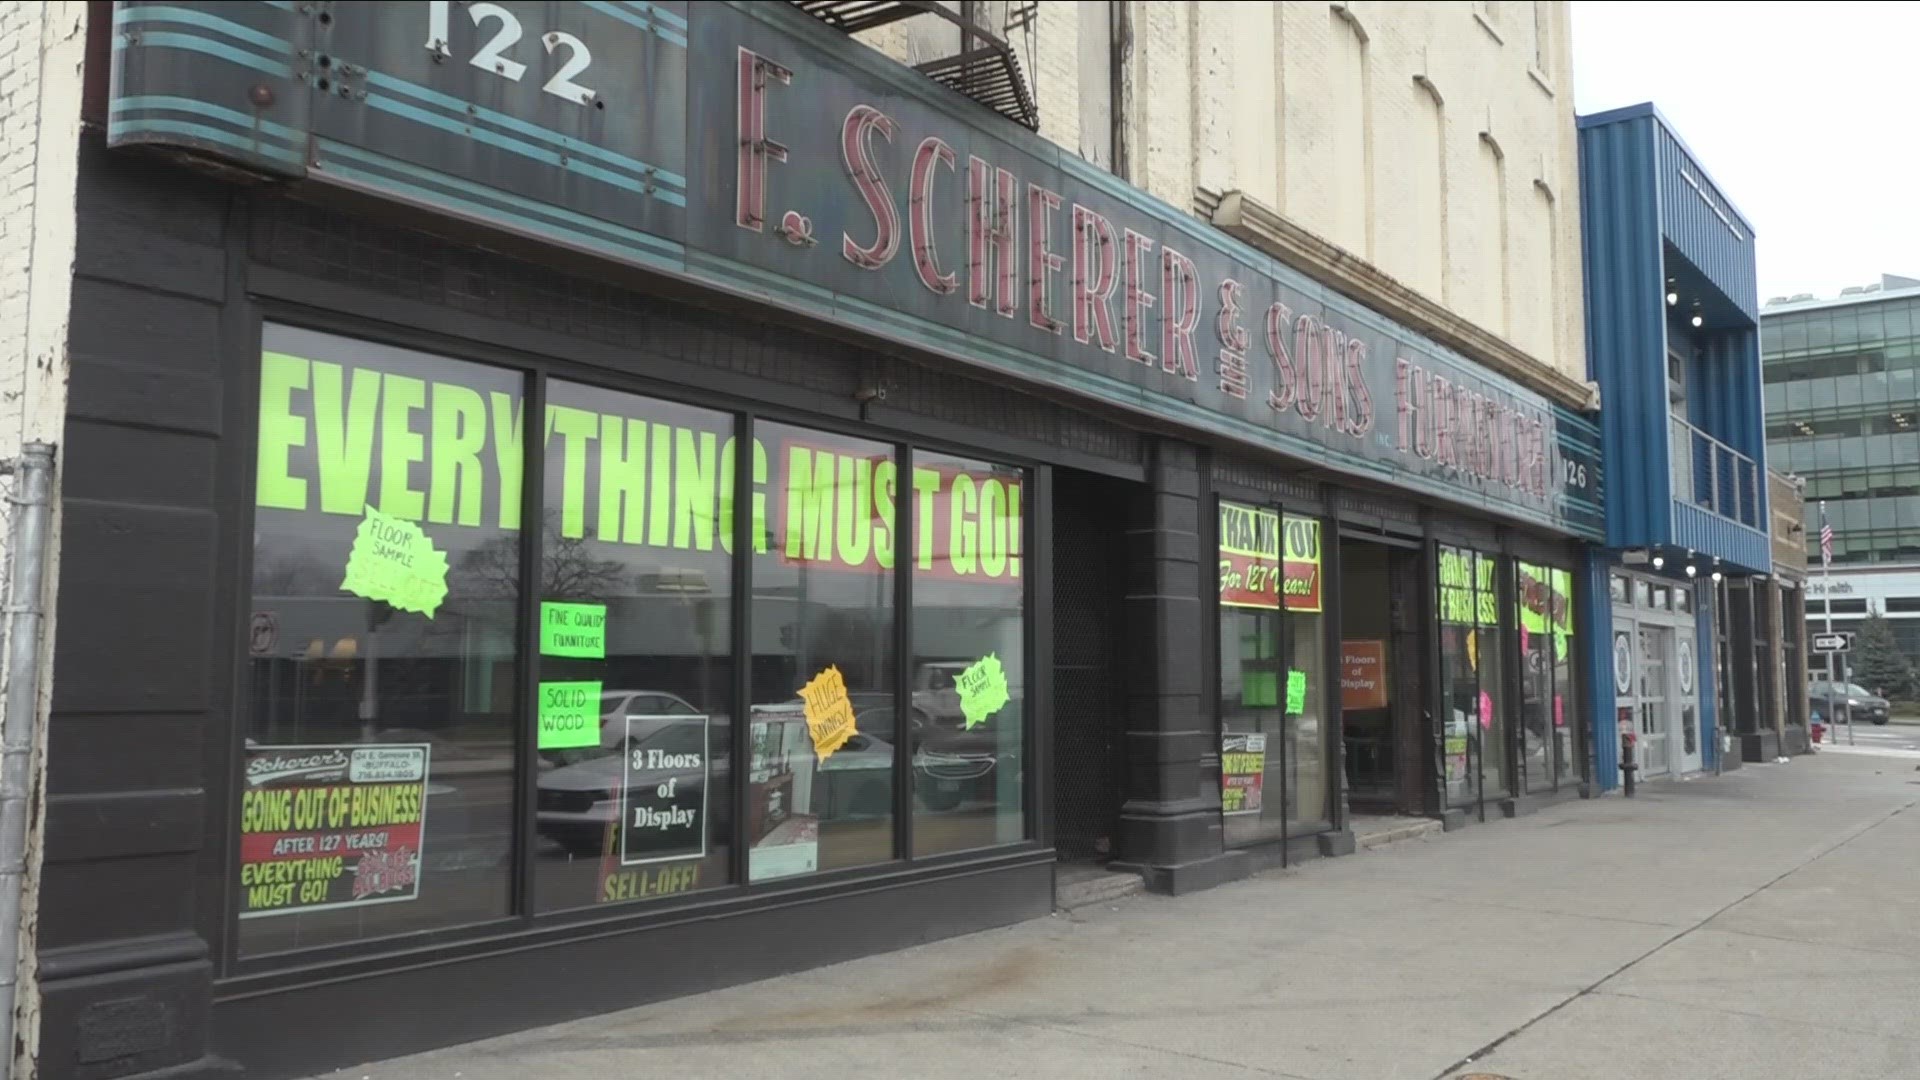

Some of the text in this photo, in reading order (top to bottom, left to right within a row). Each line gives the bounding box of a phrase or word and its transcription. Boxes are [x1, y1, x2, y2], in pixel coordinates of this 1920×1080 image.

[424, 1, 597, 106] 122
[840, 104, 1200, 382] SCHERER
[1266, 302, 1376, 440] SONS
[256, 350, 1020, 577] EVERYTHING MUST GO!
[369, 518, 414, 550] FLOOR
[371, 540, 415, 569] SAMPLE
[1246, 564, 1268, 592] 127
[548, 608, 569, 627] FINE
[553, 633, 601, 649] FURNITURE
[1345, 655, 1376, 665] Floors
[1351, 667, 1362, 676] of
[546, 688, 587, 708] SOLID
[807, 673, 844, 718] HUGE
[542, 713, 585, 732] WOOD
[246, 749, 349, 776] Scherer's
[632, 748, 701, 770] 3 Floors
[657, 777, 677, 798] of
[241, 784, 423, 833] GOING OUT OF BUSINESS!
[633, 804, 697, 831] Display
[273, 831, 389, 856] AFTER 127 YEARS!
[240, 855, 343, 886] EVERYTHING
[602, 863, 699, 902] SELL-OFF!
[248, 879, 329, 909] MUST GO!
